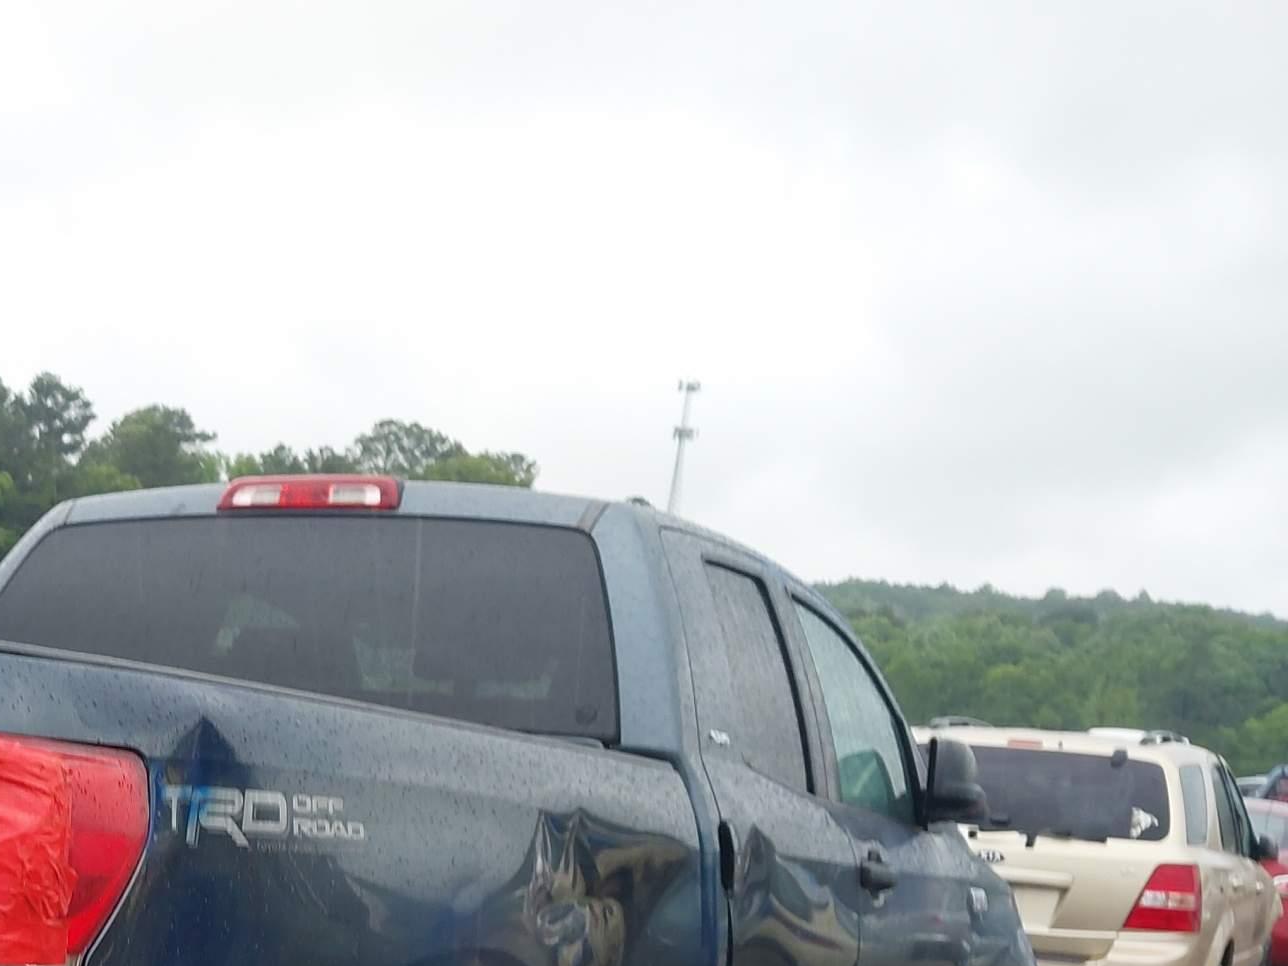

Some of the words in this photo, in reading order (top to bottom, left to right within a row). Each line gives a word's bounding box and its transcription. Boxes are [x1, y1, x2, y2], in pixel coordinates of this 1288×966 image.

[292, 793, 344, 814] OFF
[164, 784, 289, 848] TRD
[292, 817, 366, 840] ROAD
